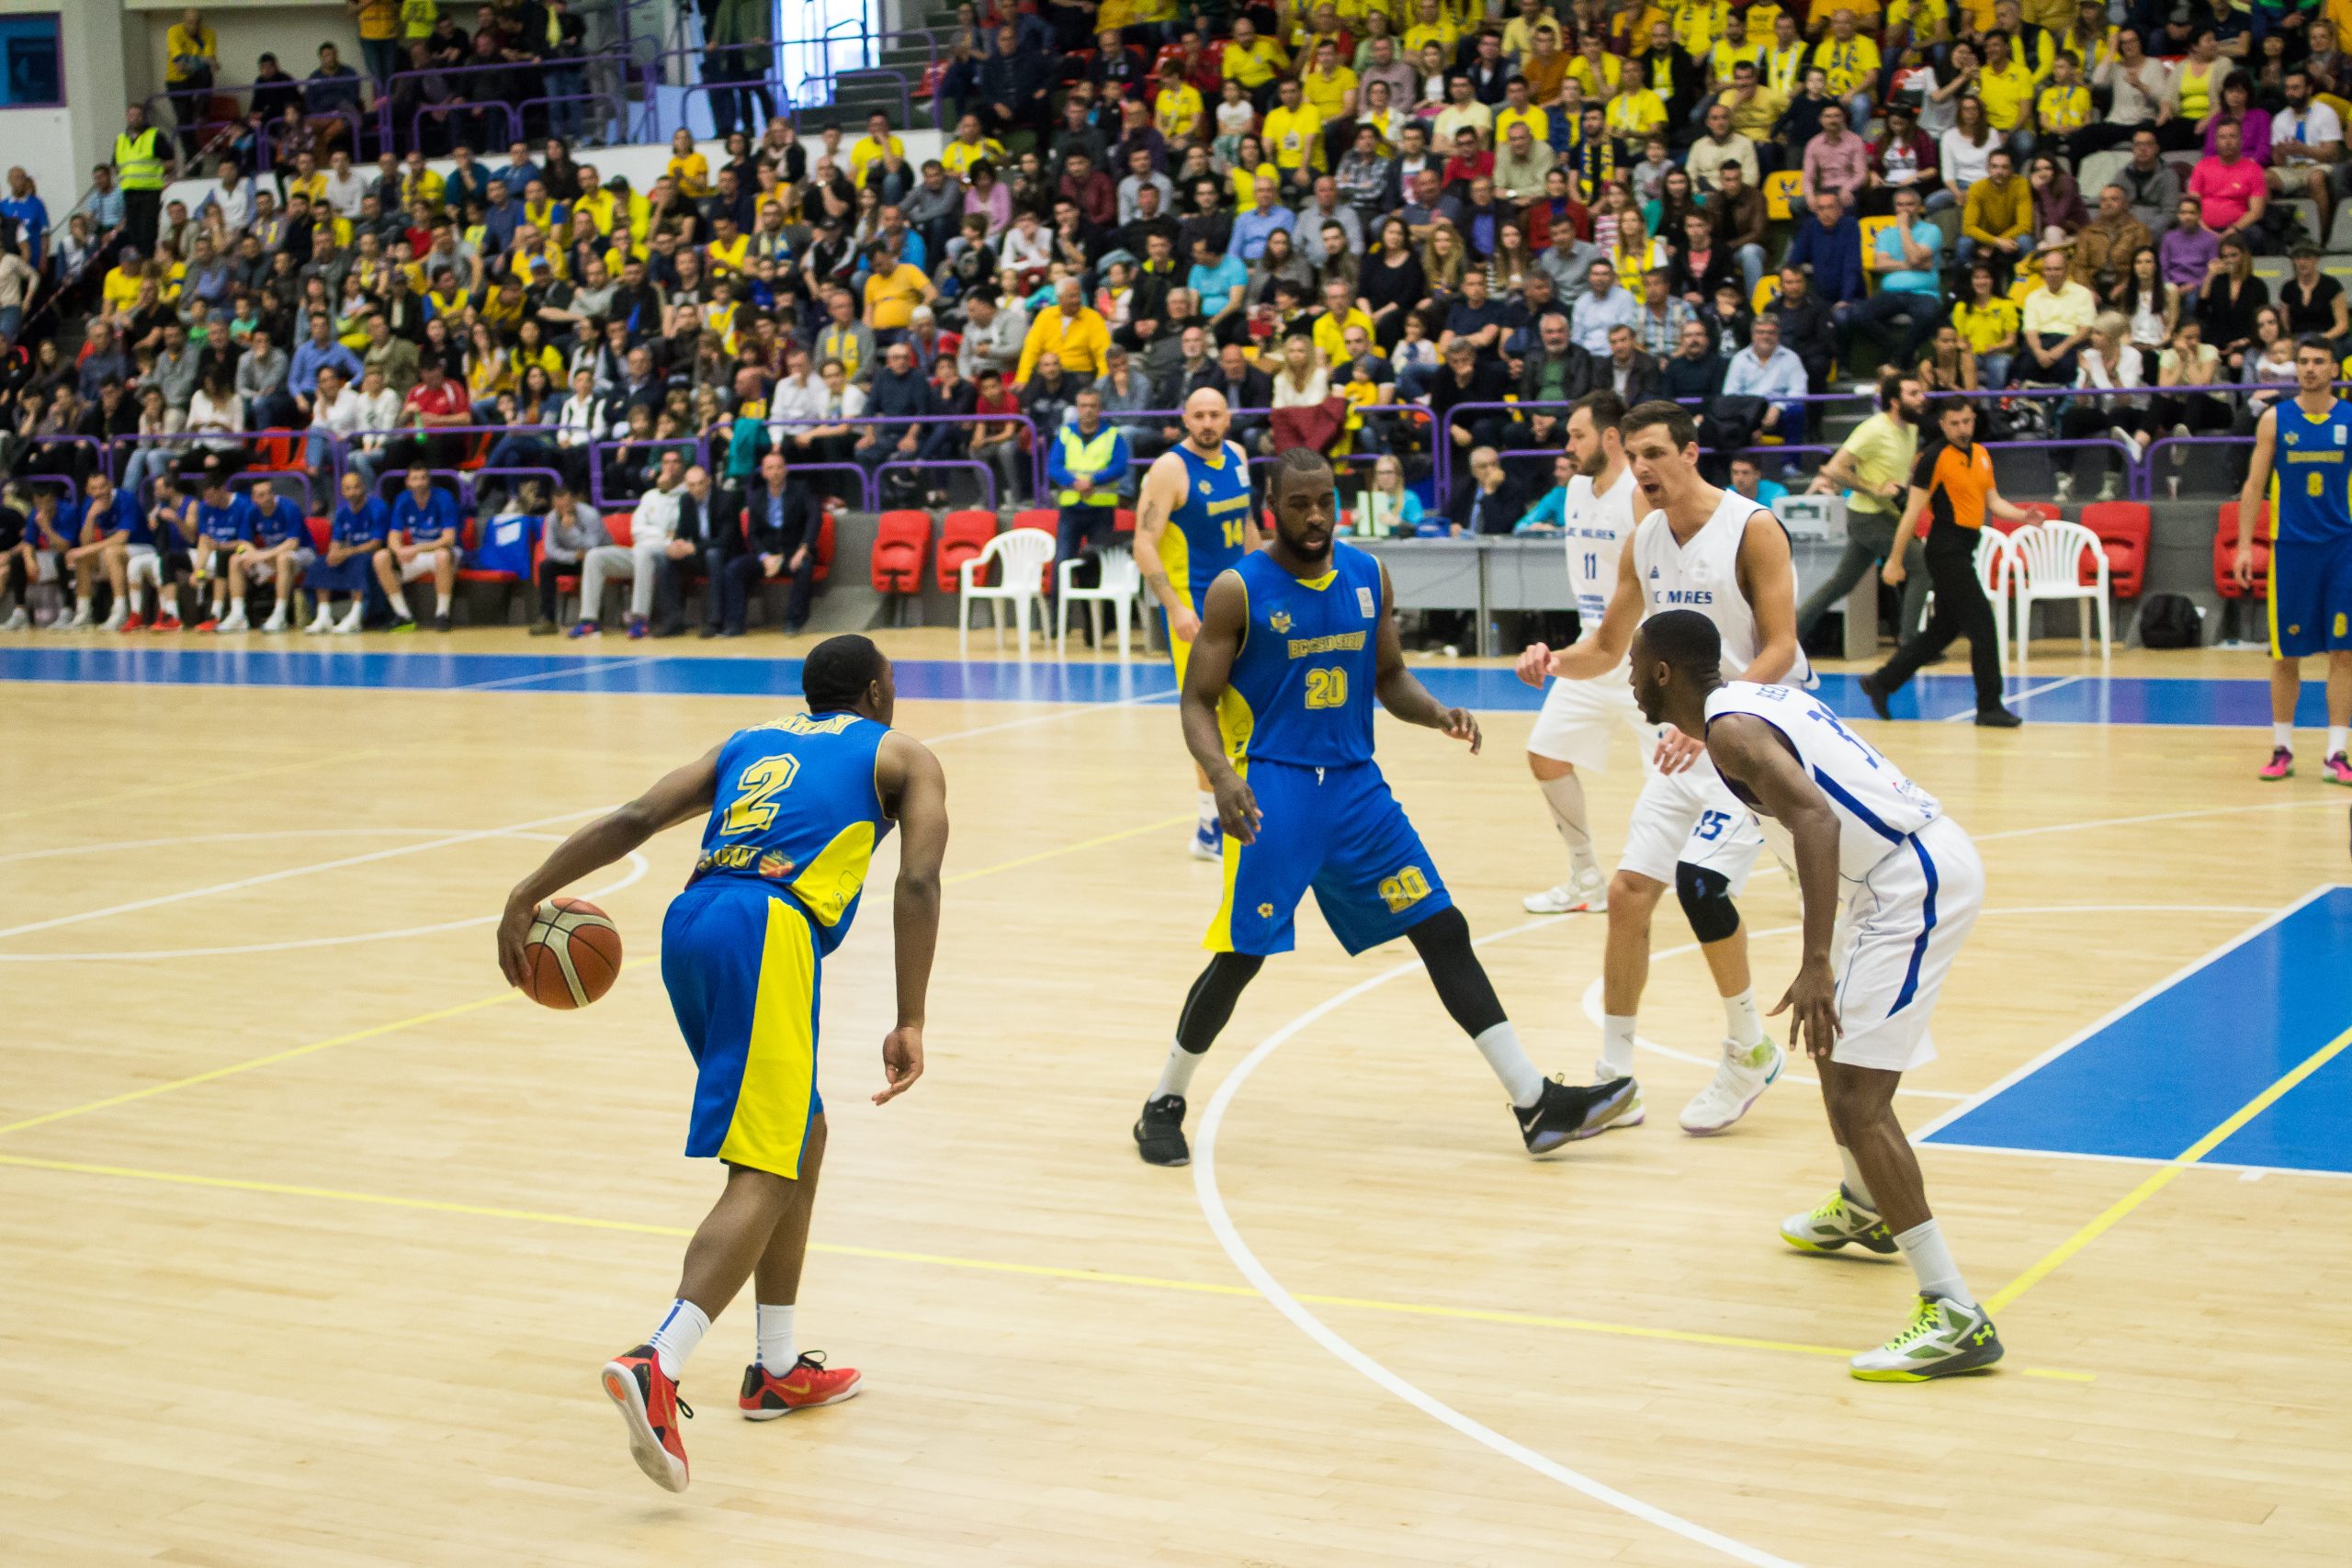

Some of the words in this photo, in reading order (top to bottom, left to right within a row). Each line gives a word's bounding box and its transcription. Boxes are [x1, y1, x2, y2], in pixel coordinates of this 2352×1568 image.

[1220, 518, 1244, 548] 14
[1584, 552, 1597, 580] 11
[1305, 666, 1348, 709] 20
[720, 752, 801, 836] 2
[1378, 864, 1433, 915] 20
